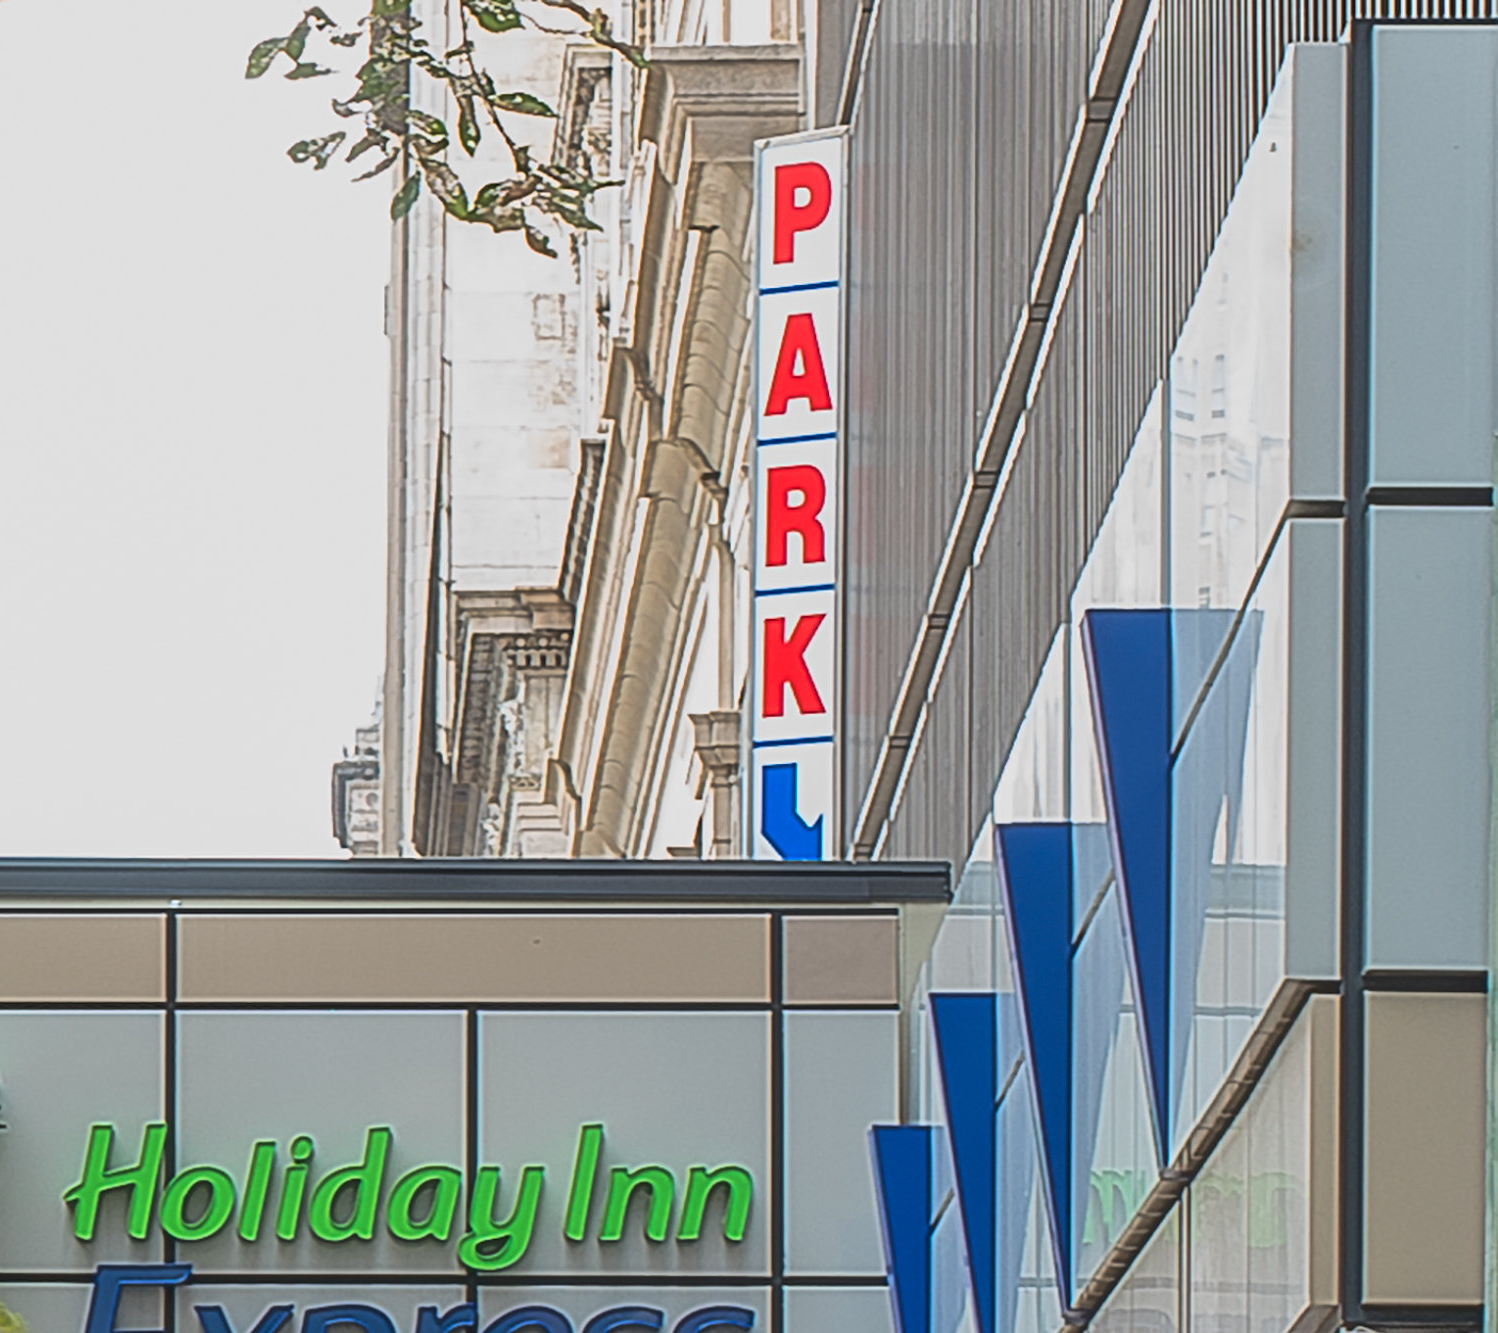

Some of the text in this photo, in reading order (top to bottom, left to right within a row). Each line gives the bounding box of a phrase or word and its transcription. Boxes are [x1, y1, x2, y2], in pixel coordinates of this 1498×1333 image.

[762, 161, 834, 719] PARK
[63, 1121, 755, 1272] Holiday Inn
